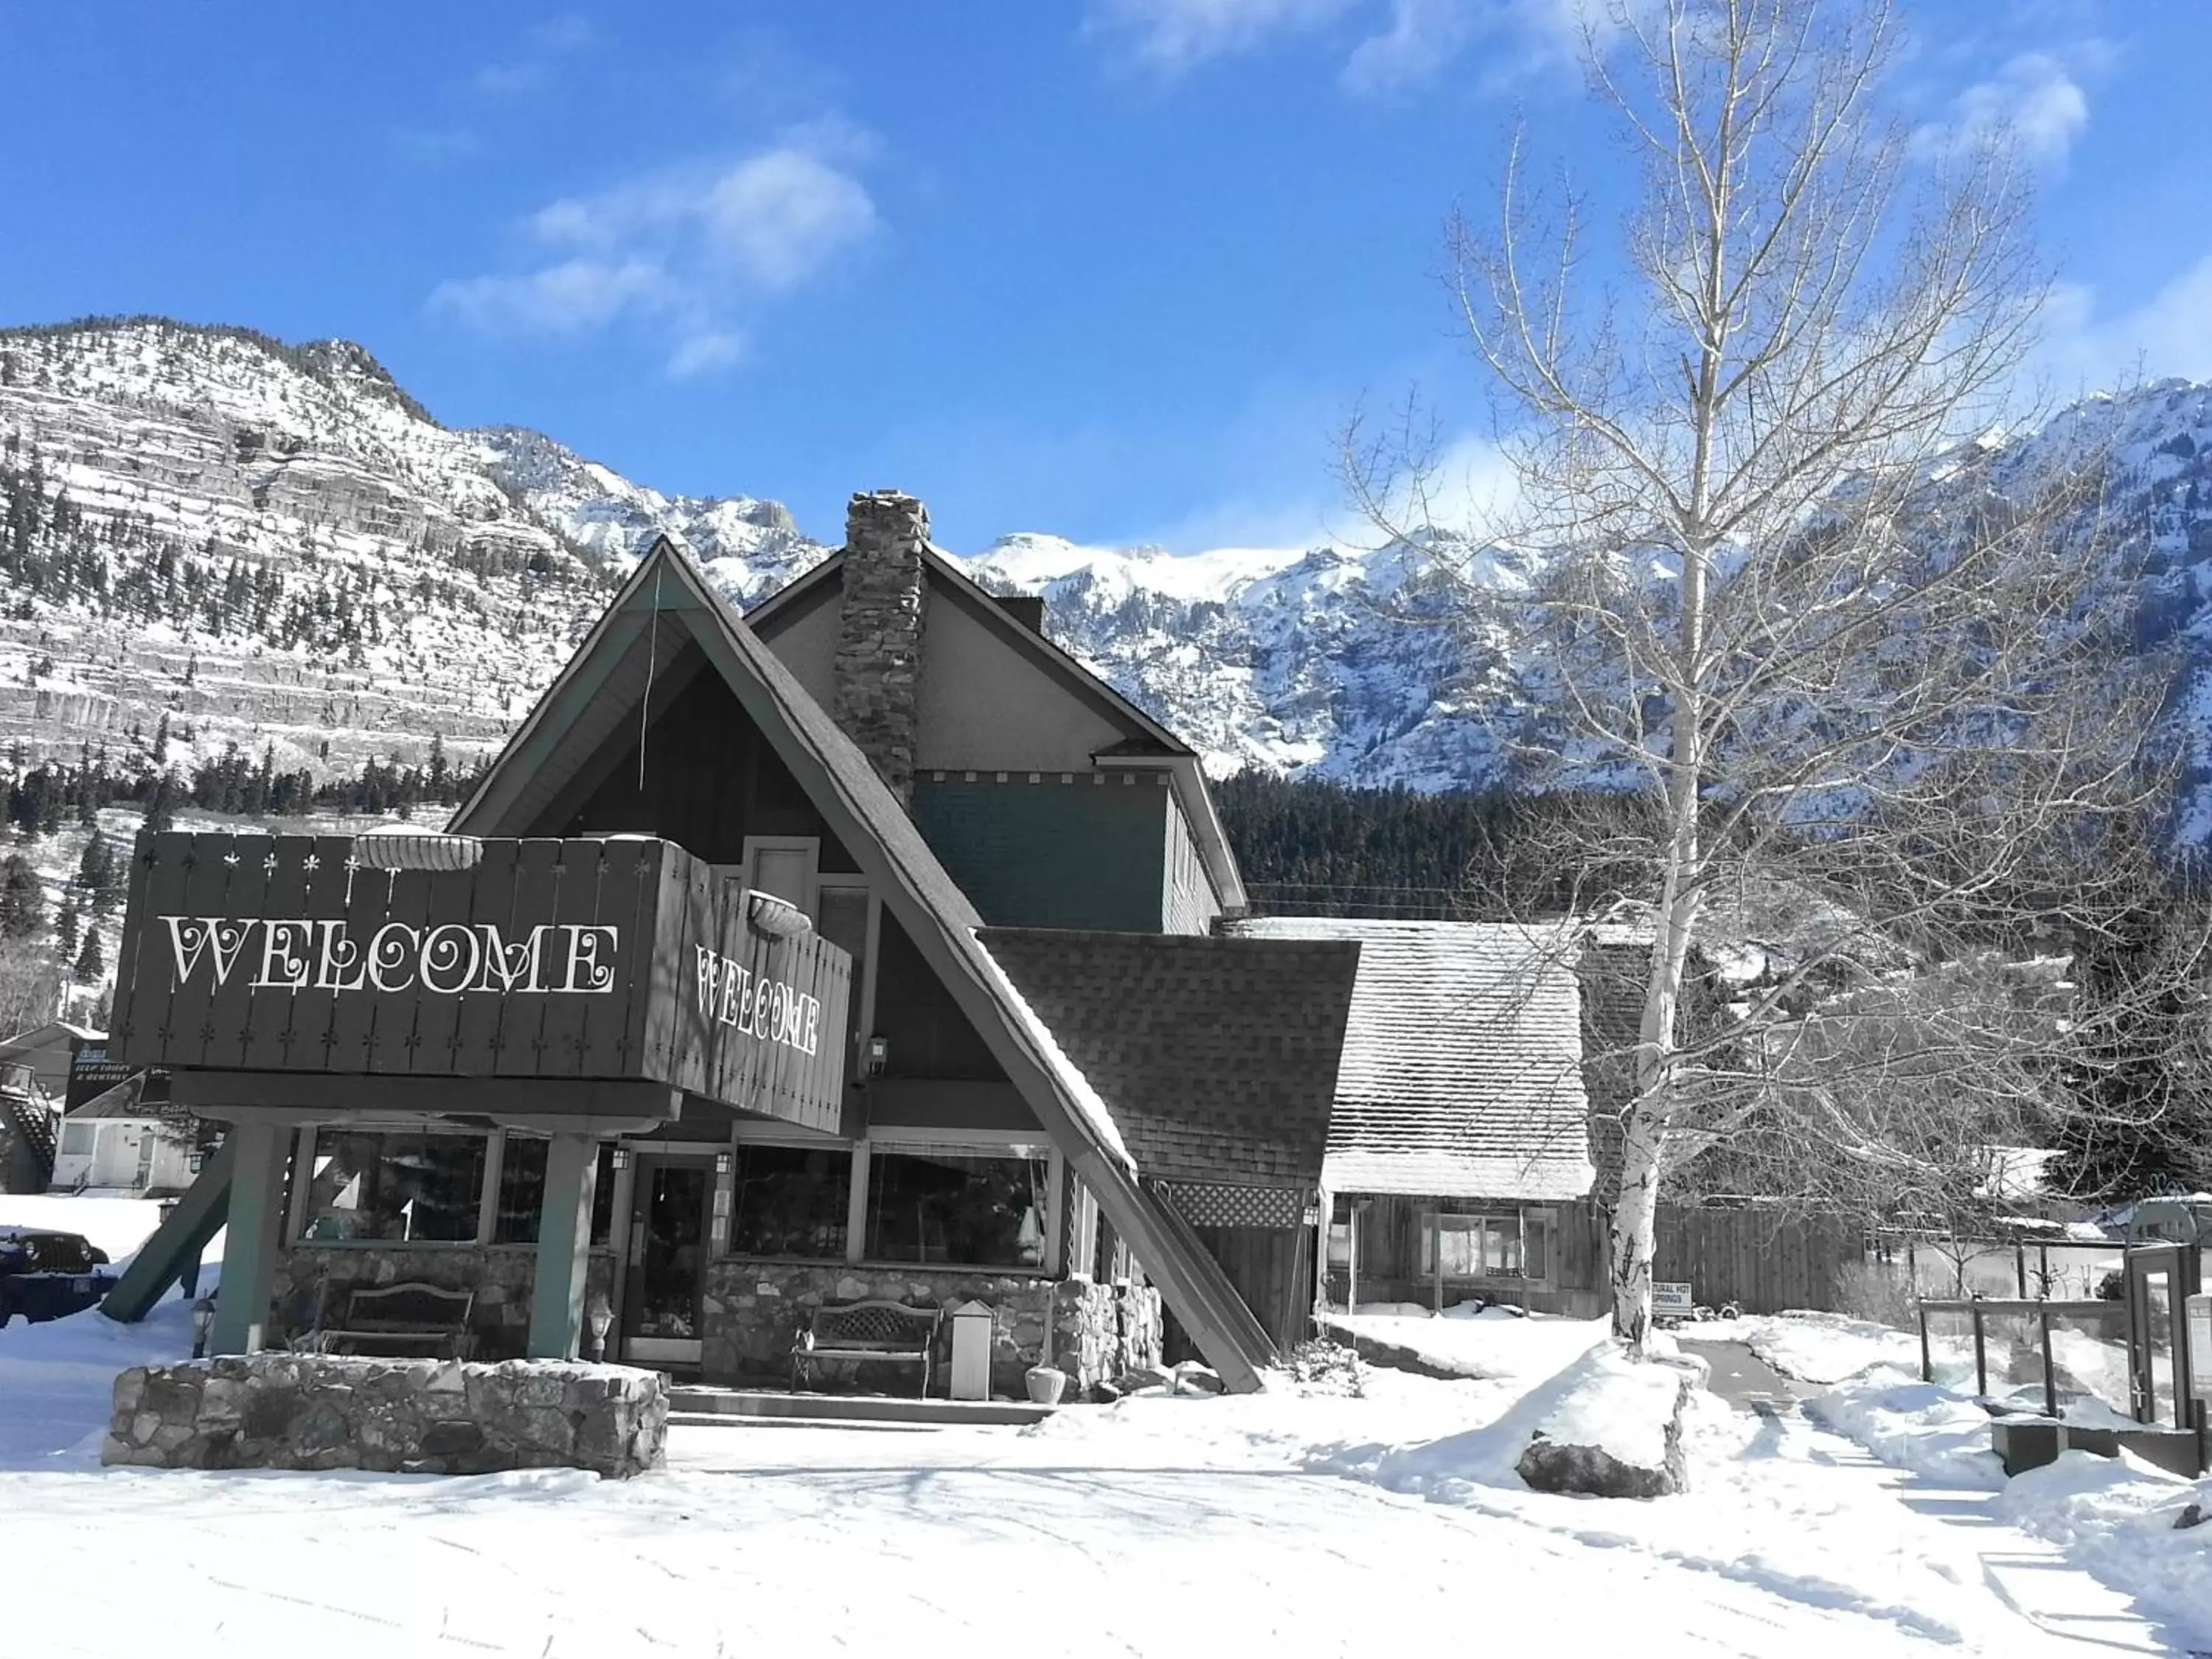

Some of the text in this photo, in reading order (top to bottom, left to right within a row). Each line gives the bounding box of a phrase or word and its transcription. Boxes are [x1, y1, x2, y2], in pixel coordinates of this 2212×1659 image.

[157, 915, 618, 994] WELCOME
[695, 943, 821, 1057] WELCOME
[1652, 1284, 1674, 1293] TURAL
